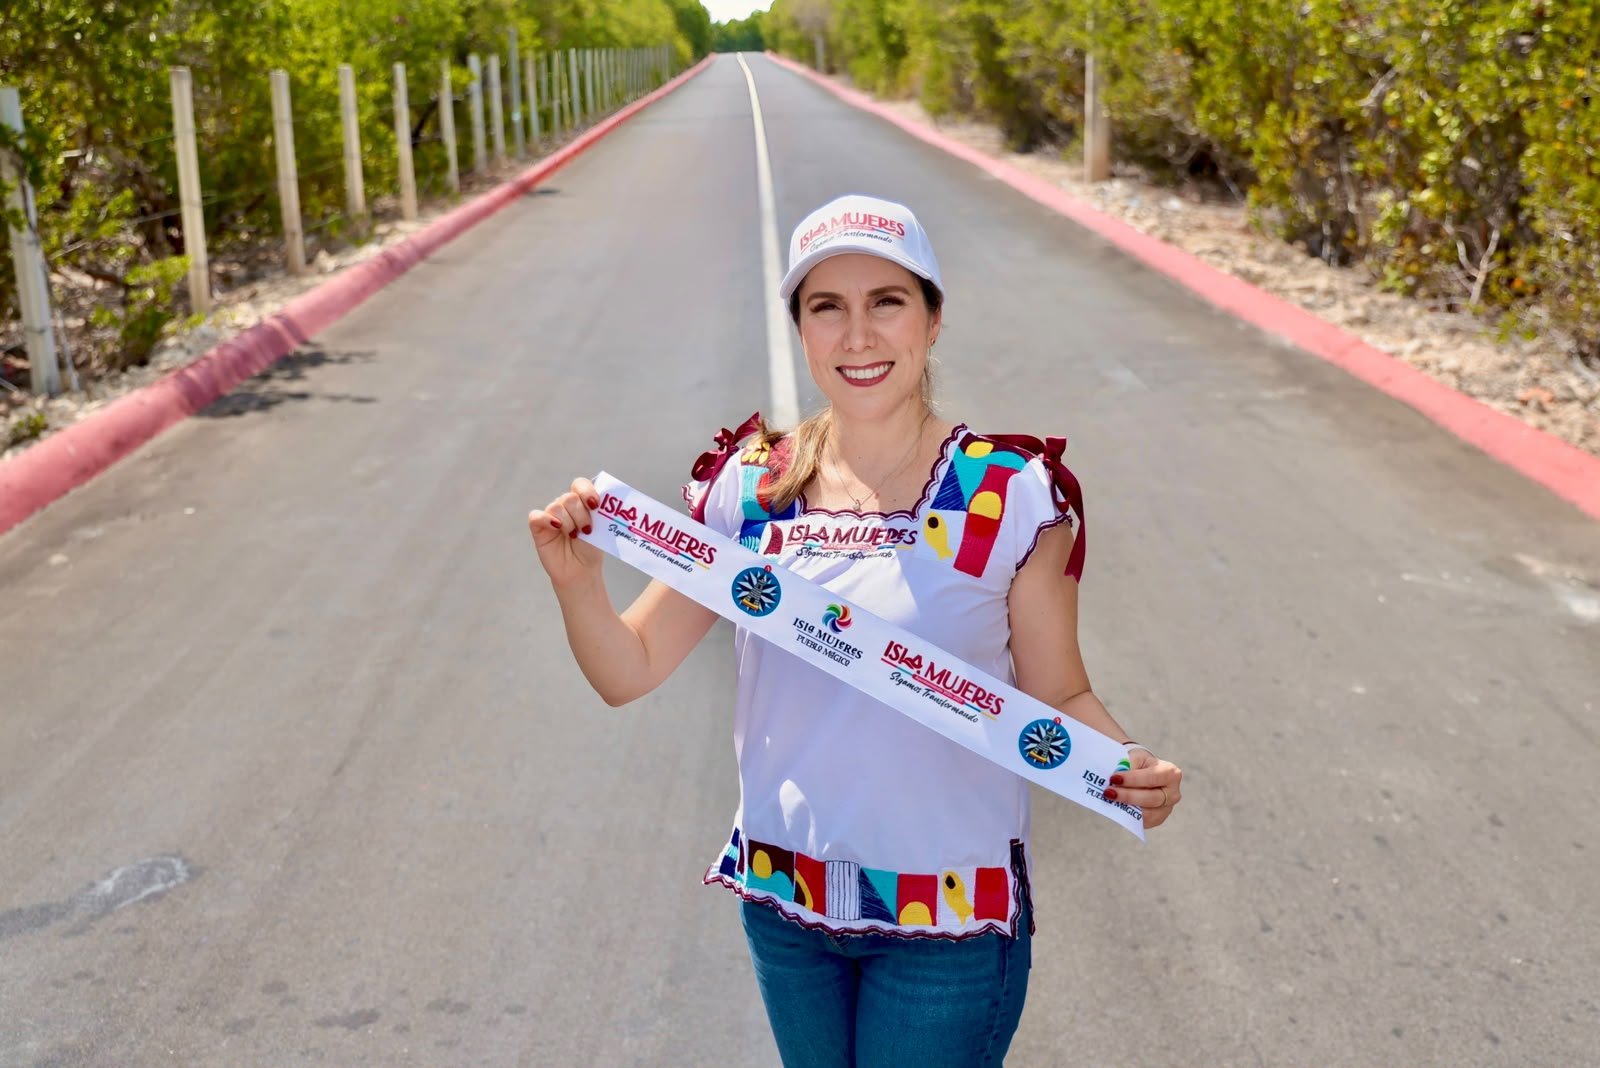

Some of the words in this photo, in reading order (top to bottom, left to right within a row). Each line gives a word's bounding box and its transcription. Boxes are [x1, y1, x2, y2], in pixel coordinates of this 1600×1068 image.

[800, 222, 828, 251] ISLA
[831, 212, 905, 237] MUJERES
[600, 493, 637, 523] ISLA
[639, 513, 717, 564] MUJERES
[608, 523, 638, 545] Sigamos
[639, 539, 693, 573] Transformando
[787, 524, 829, 542] ISLA
[831, 526, 918, 545] MUJERES
[796, 634, 823, 653] PUEBLO
[884, 640, 923, 670] ISLA
[924, 661, 1005, 715] MUJERES
[889, 671, 922, 694] Sigamos
[921, 688, 979, 723] Transformando
